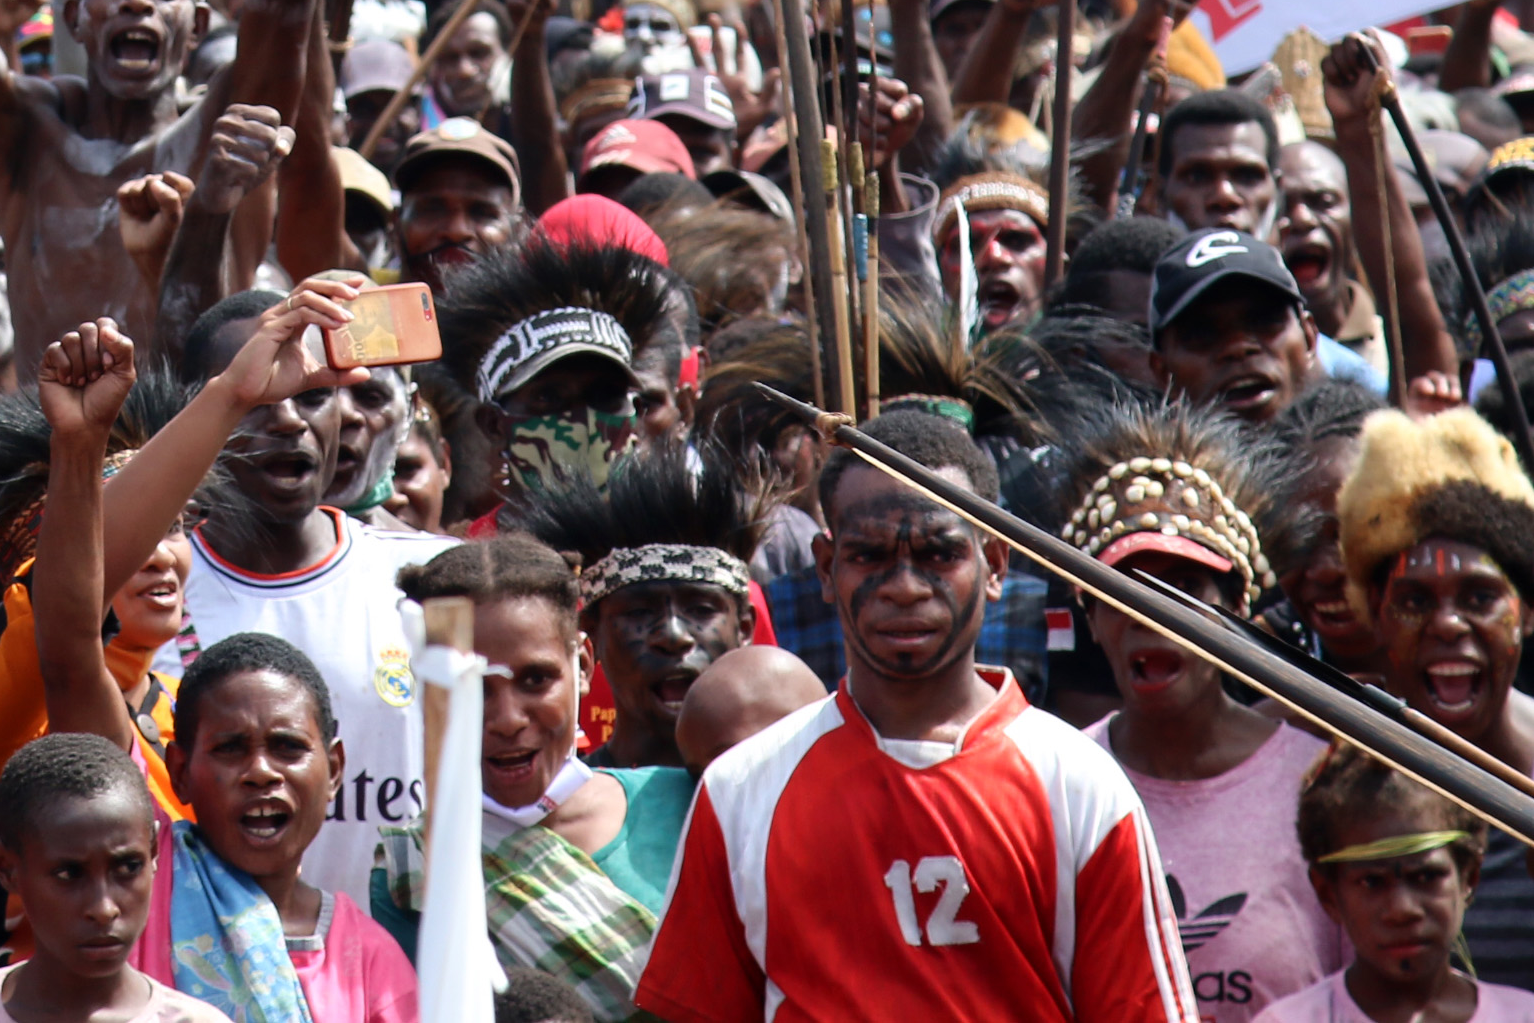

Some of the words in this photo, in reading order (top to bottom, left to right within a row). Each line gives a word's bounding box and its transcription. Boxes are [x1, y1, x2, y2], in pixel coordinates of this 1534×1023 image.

[590, 705, 617, 724] Pap
[883, 855, 982, 947] 12
[1191, 969, 1254, 1005] as
